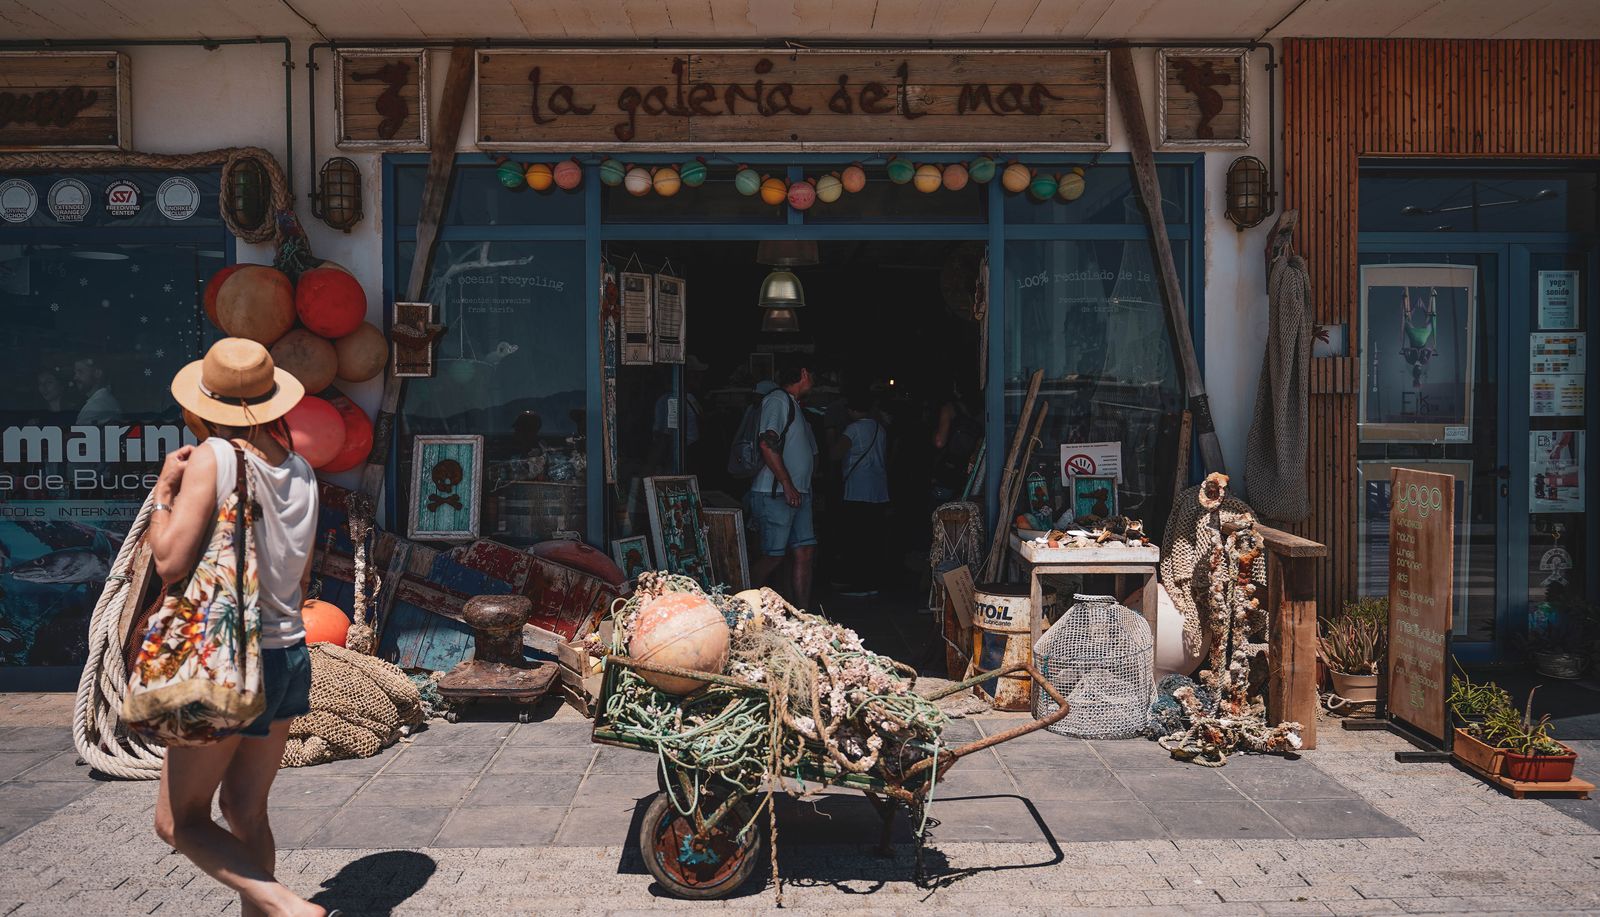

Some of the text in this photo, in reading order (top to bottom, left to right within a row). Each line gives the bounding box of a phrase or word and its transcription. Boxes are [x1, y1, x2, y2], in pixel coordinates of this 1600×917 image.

[528, 57, 1065, 142] la galeria del mar
[111, 191, 133, 203] SSI
[458, 275, 494, 285] ocean
[500, 274, 564, 292] recycling
[1016, 270, 1151, 289] 100% reciclado de la
[1549, 279, 1566, 287] yoga
[1546, 288, 1569, 296] sonido
[3, 425, 198, 463] marin
[24, 469, 64, 490] de
[1397, 481, 1442, 517] yoga
[983, 618, 1012, 627] Lubricante
